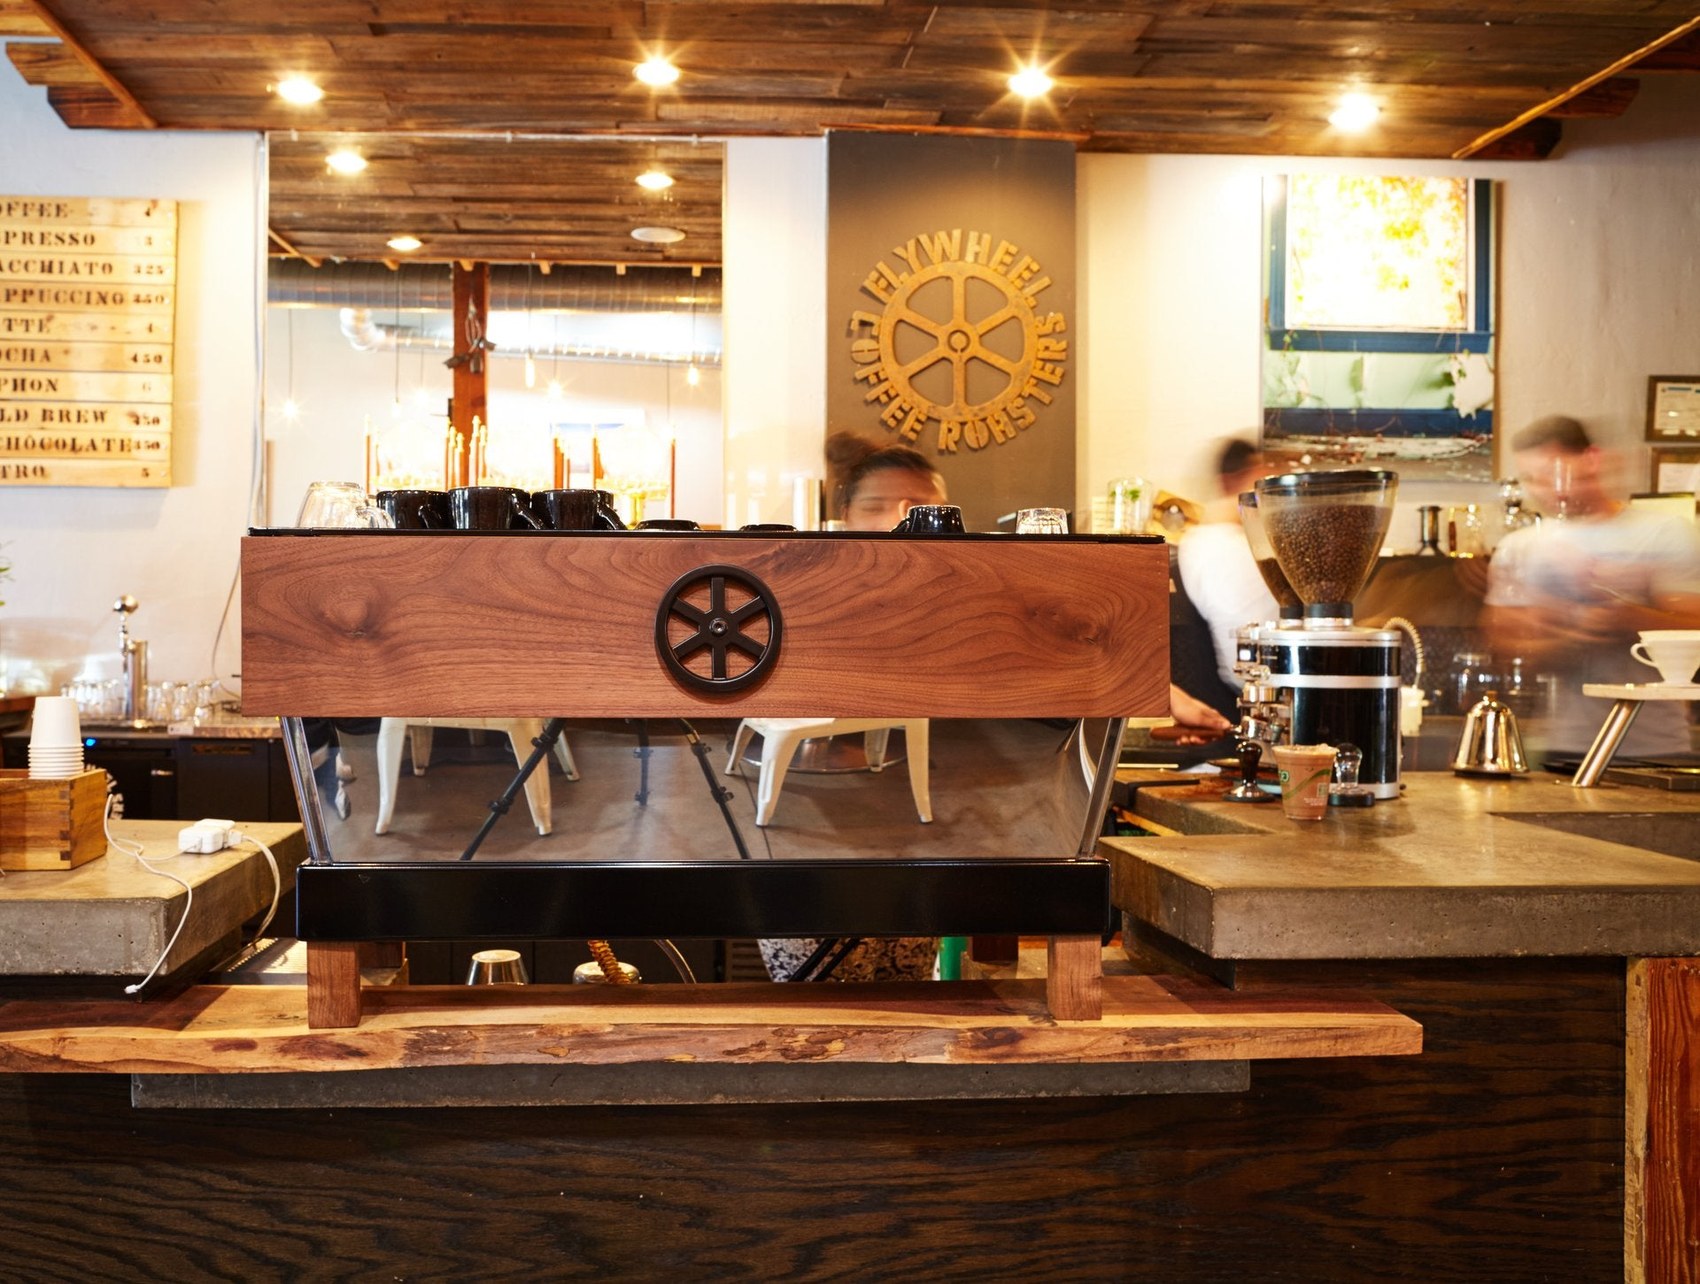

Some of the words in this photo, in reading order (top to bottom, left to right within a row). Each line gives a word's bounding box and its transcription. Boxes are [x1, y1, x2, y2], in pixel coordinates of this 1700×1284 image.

[0, 201, 69, 218] FFEE
[0, 230, 96, 246] PRESSO
[861, 229, 1051, 309] FLYWHEEL
[0, 347, 51, 363] CHA
[850, 310, 929, 442] COFFEE
[938, 312, 1068, 453] ROASTERS
[41, 407, 107, 424] BREW
[0, 437, 132, 454] HOCOLATE
